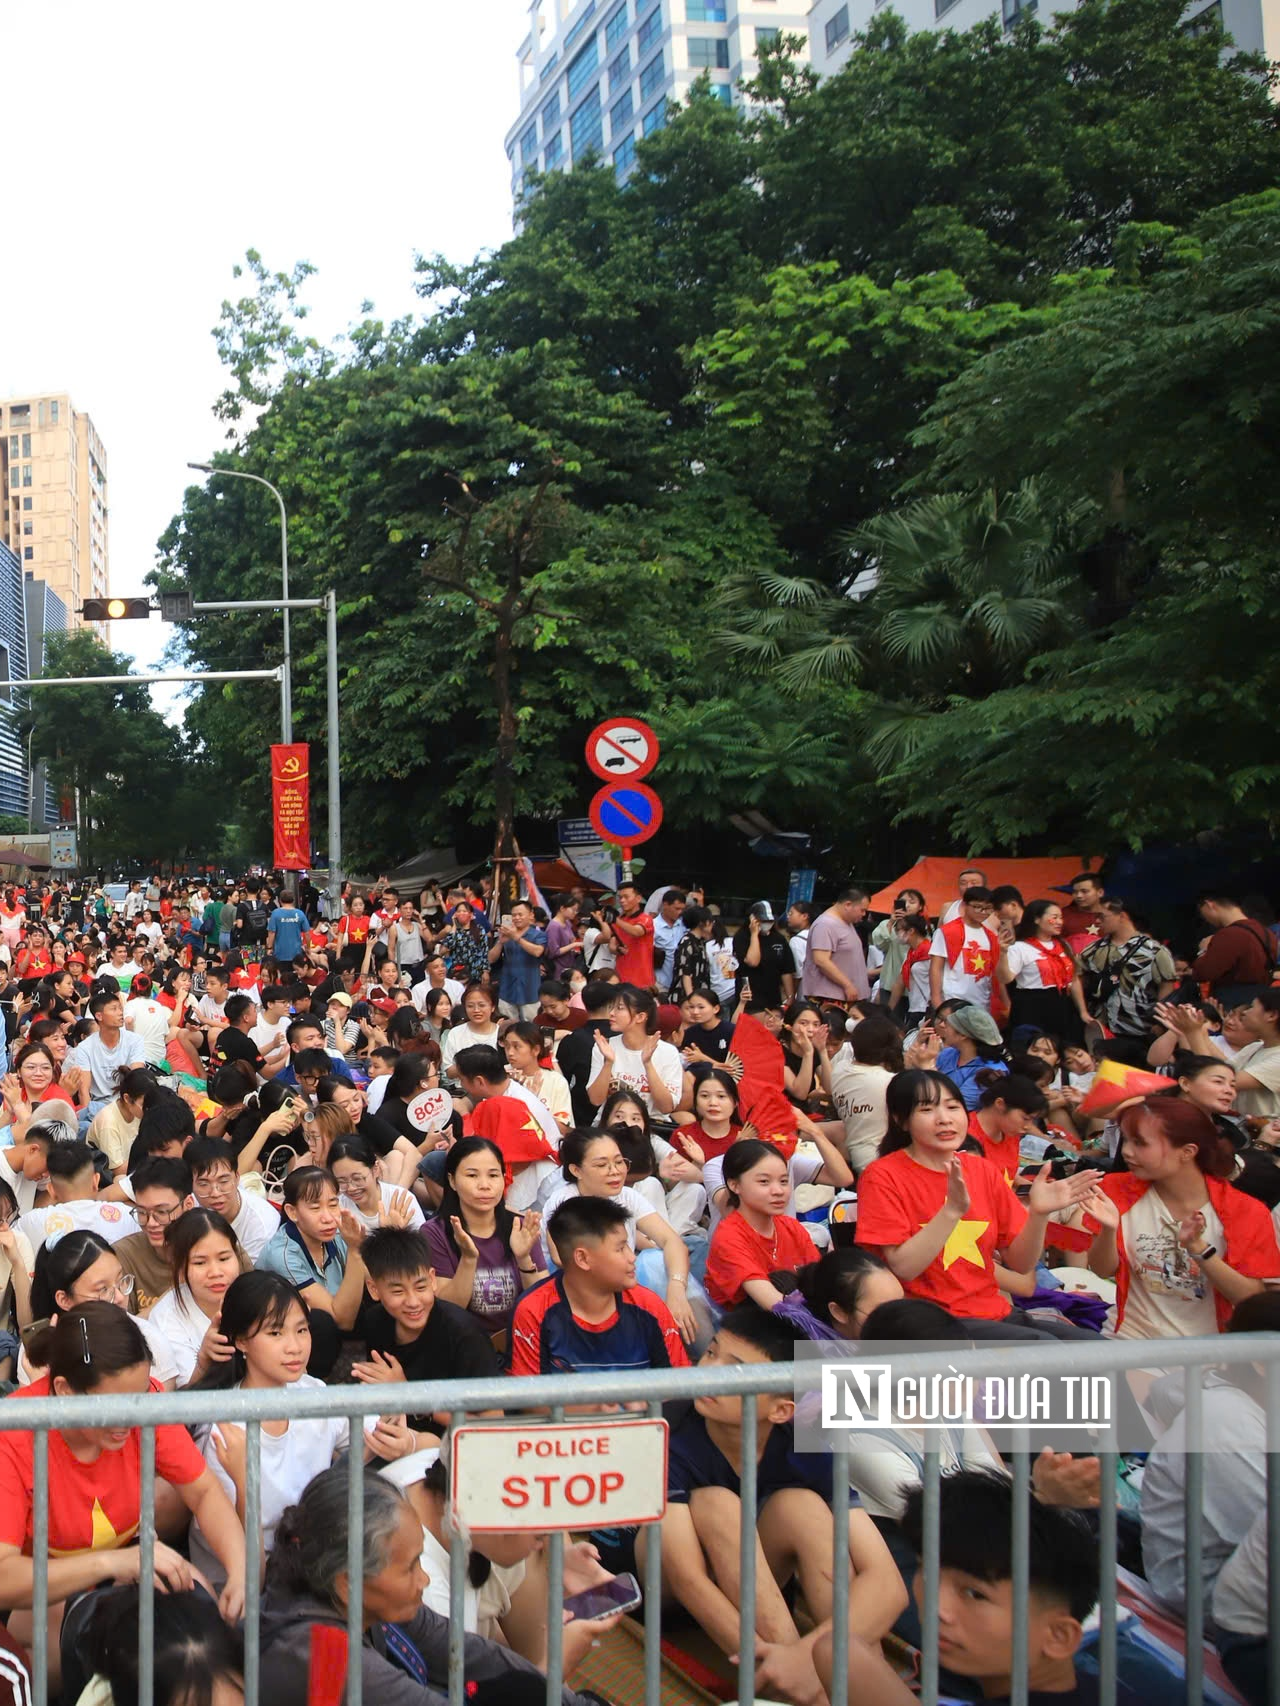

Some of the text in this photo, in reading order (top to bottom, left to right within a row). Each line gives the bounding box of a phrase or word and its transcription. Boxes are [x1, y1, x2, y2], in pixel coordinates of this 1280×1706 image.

[414, 1101, 435, 1121] 80
[517, 1436, 611, 1458] POLICE
[501, 1471, 625, 1509] STOP
